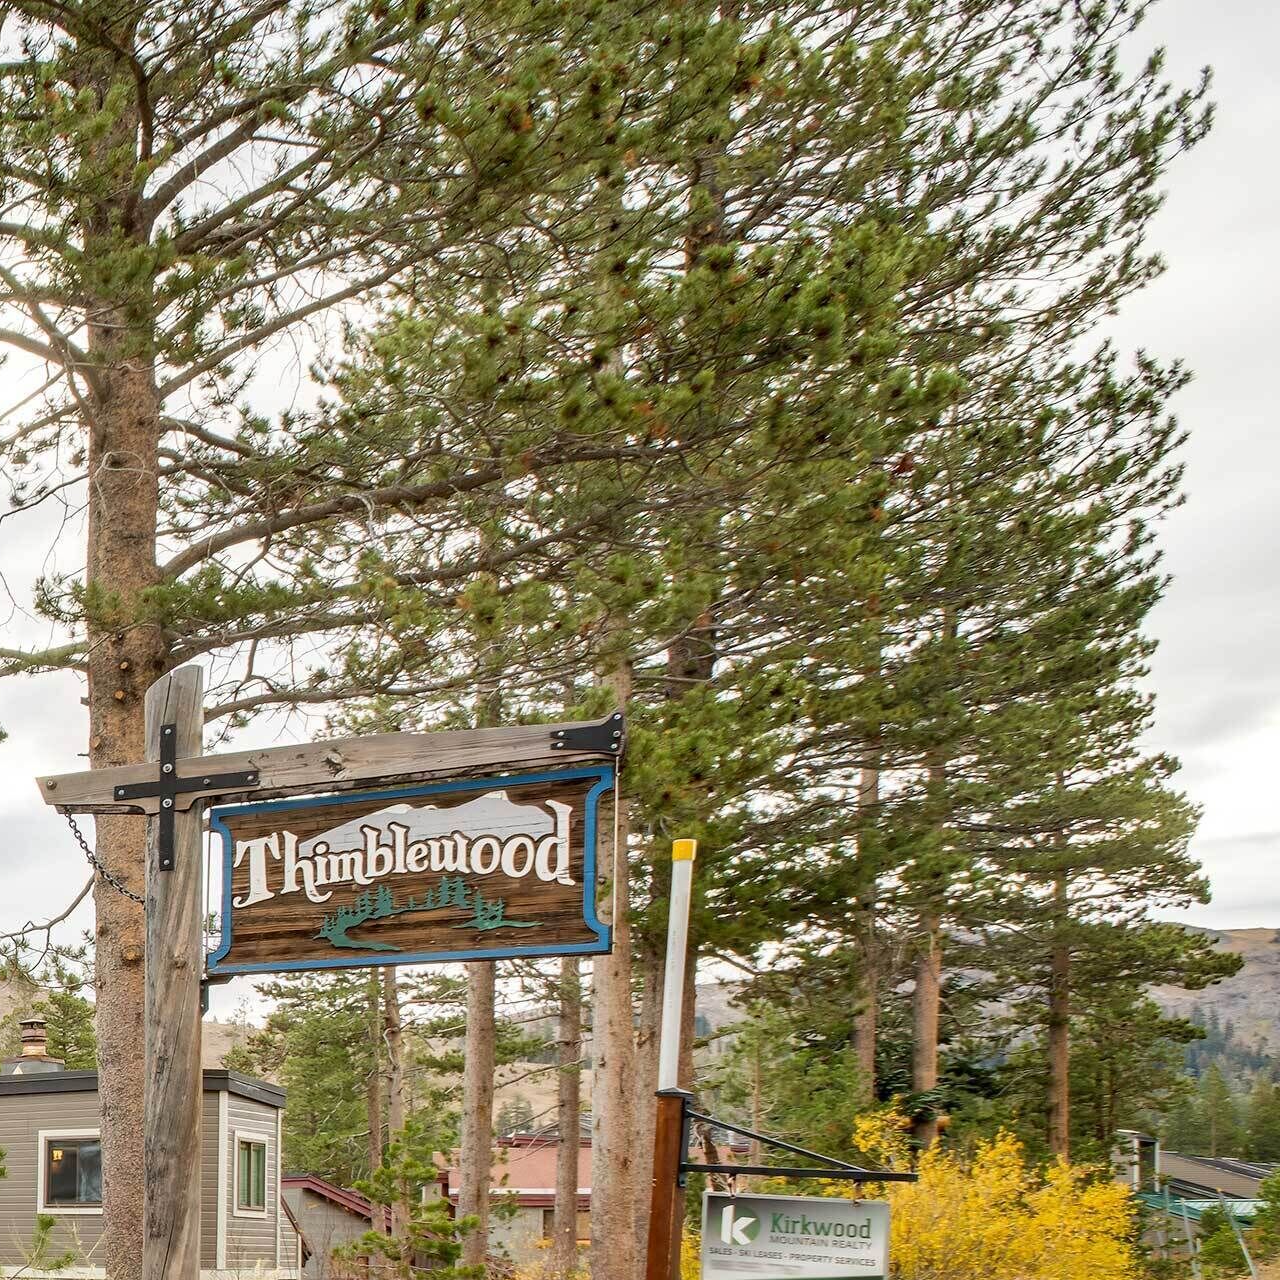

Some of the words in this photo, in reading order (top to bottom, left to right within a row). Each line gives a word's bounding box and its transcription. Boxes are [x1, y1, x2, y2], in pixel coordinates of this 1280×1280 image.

[232, 799, 576, 908] Thimblewood
[770, 1212, 872, 1239] Kirkwood
[769, 1236, 829, 1248] MOUNTAIN
[832, 1240, 873, 1250] REALTY
[709, 1247, 733, 1256] SALES
[739, 1249, 753, 1258] SKI
[753, 1250, 783, 1260] LEASES
[790, 1253, 832, 1263] PROPERTY
[834, 1256, 877, 1267] SERVICES
